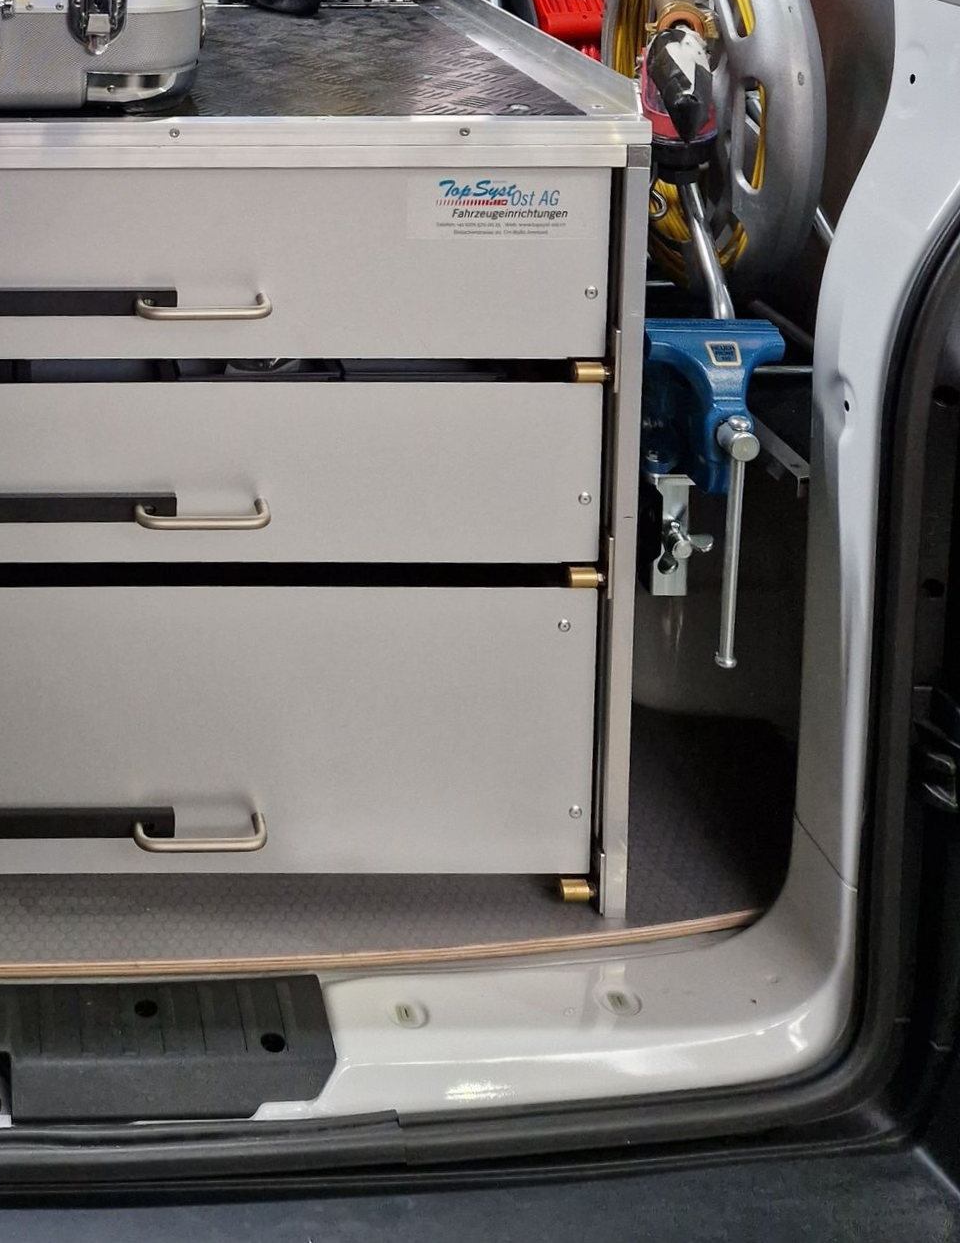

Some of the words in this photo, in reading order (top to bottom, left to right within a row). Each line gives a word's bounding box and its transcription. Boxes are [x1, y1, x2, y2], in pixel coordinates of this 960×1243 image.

[511, 190, 536, 207] Ost
[539, 190, 561, 207] AG
[451, 208, 568, 220] Fahrzeugeinrichtungen
